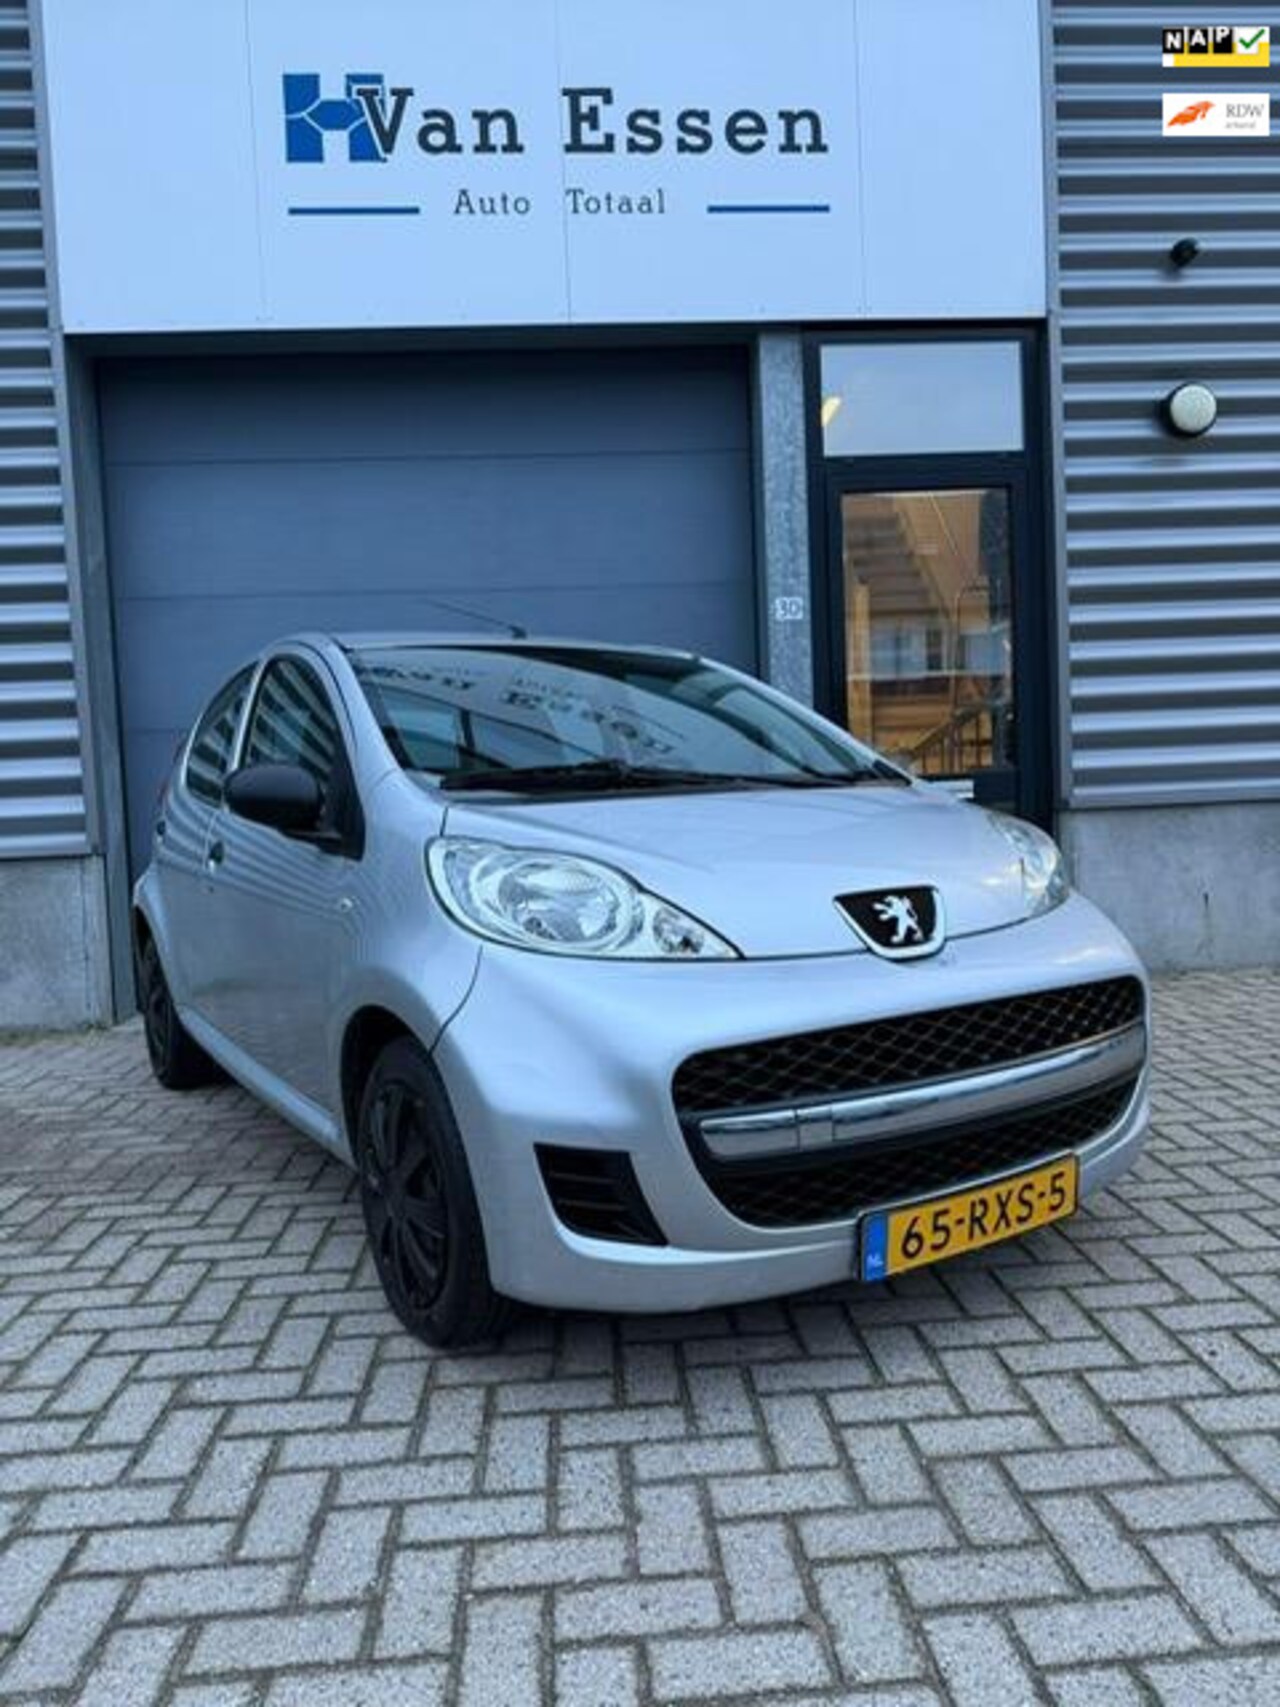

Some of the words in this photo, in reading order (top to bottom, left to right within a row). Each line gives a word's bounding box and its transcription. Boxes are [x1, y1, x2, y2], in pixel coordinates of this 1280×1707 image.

[356, 87, 525, 156] Van
[562, 87, 828, 155] Essen
[453, 189, 531, 215] Auto
[565, 188, 666, 215] Totaal
[901, 1171, 1066, 1259] 65-RXS-5
